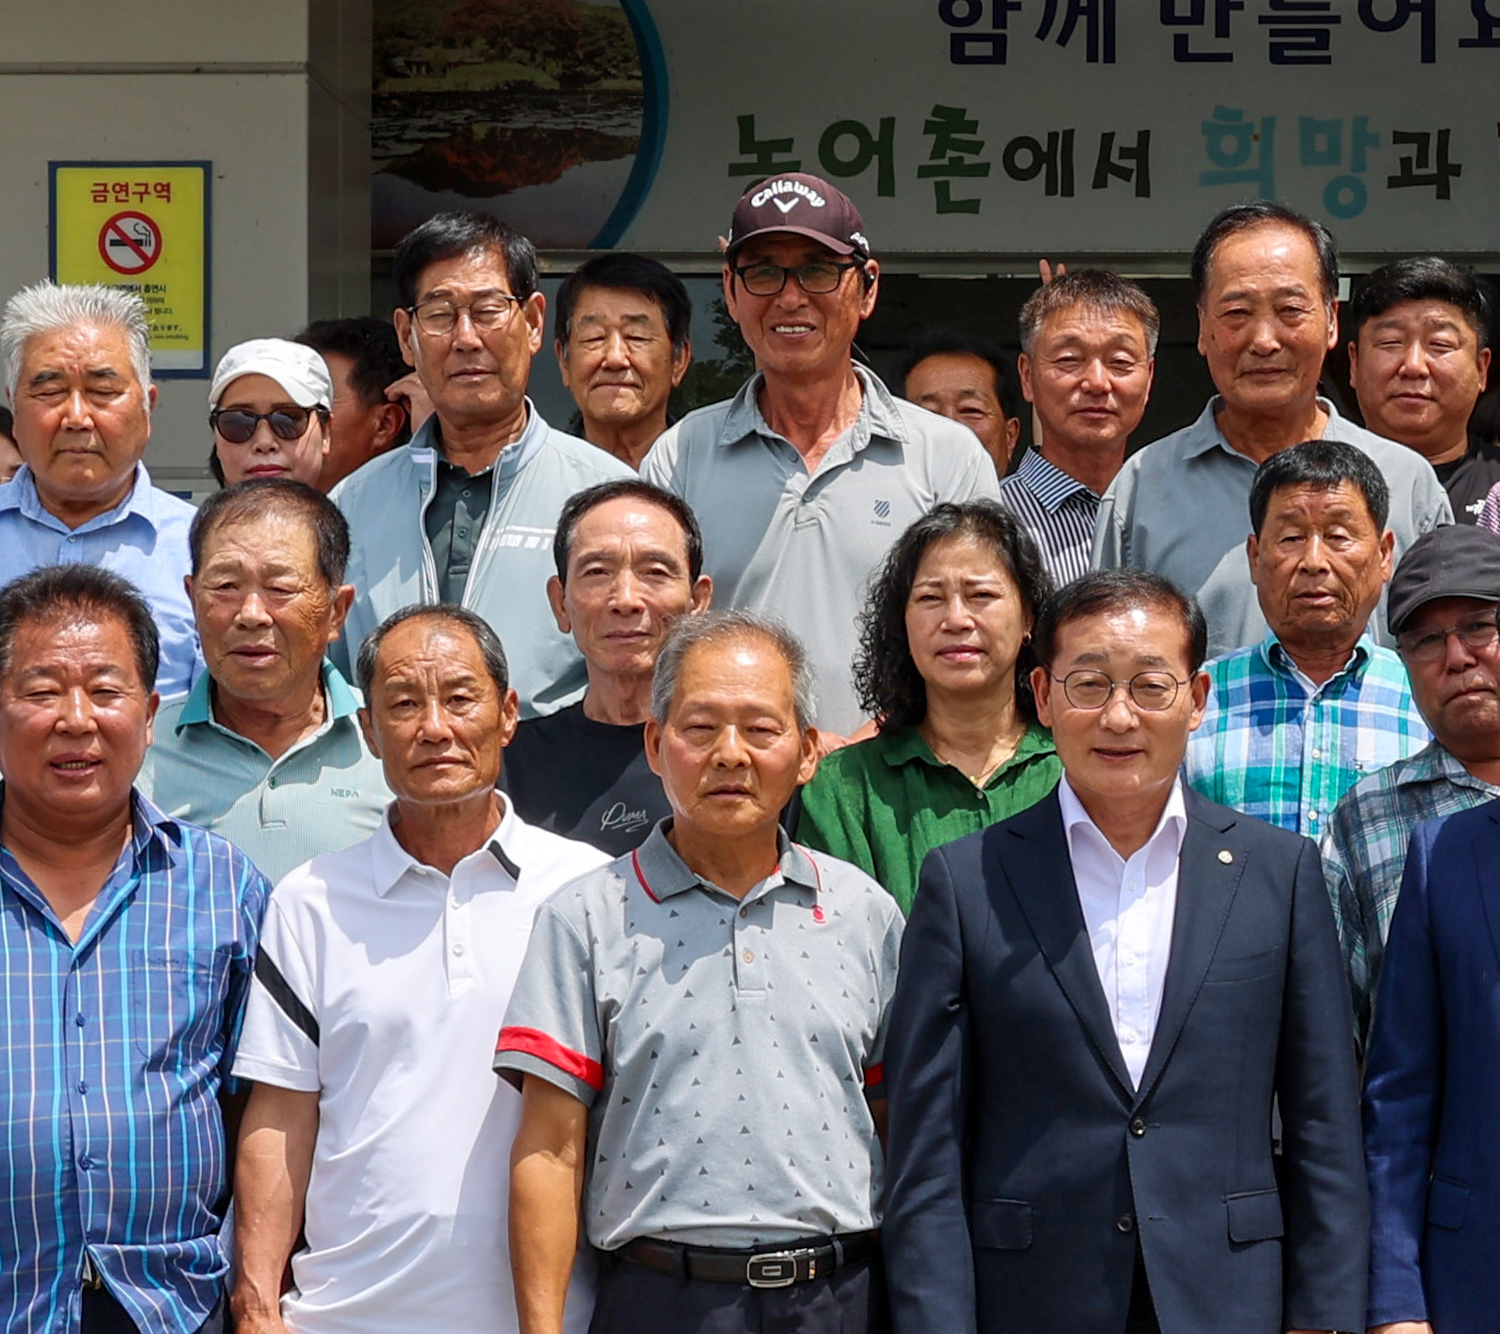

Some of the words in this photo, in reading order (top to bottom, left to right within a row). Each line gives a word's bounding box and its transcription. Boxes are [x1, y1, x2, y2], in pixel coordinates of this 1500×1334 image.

[1200, 104, 1462, 219] 희망과
[91, 183, 171, 203] 금연구역
[751, 180, 826, 208] Callaway
[331, 788, 359, 798] NEPA
